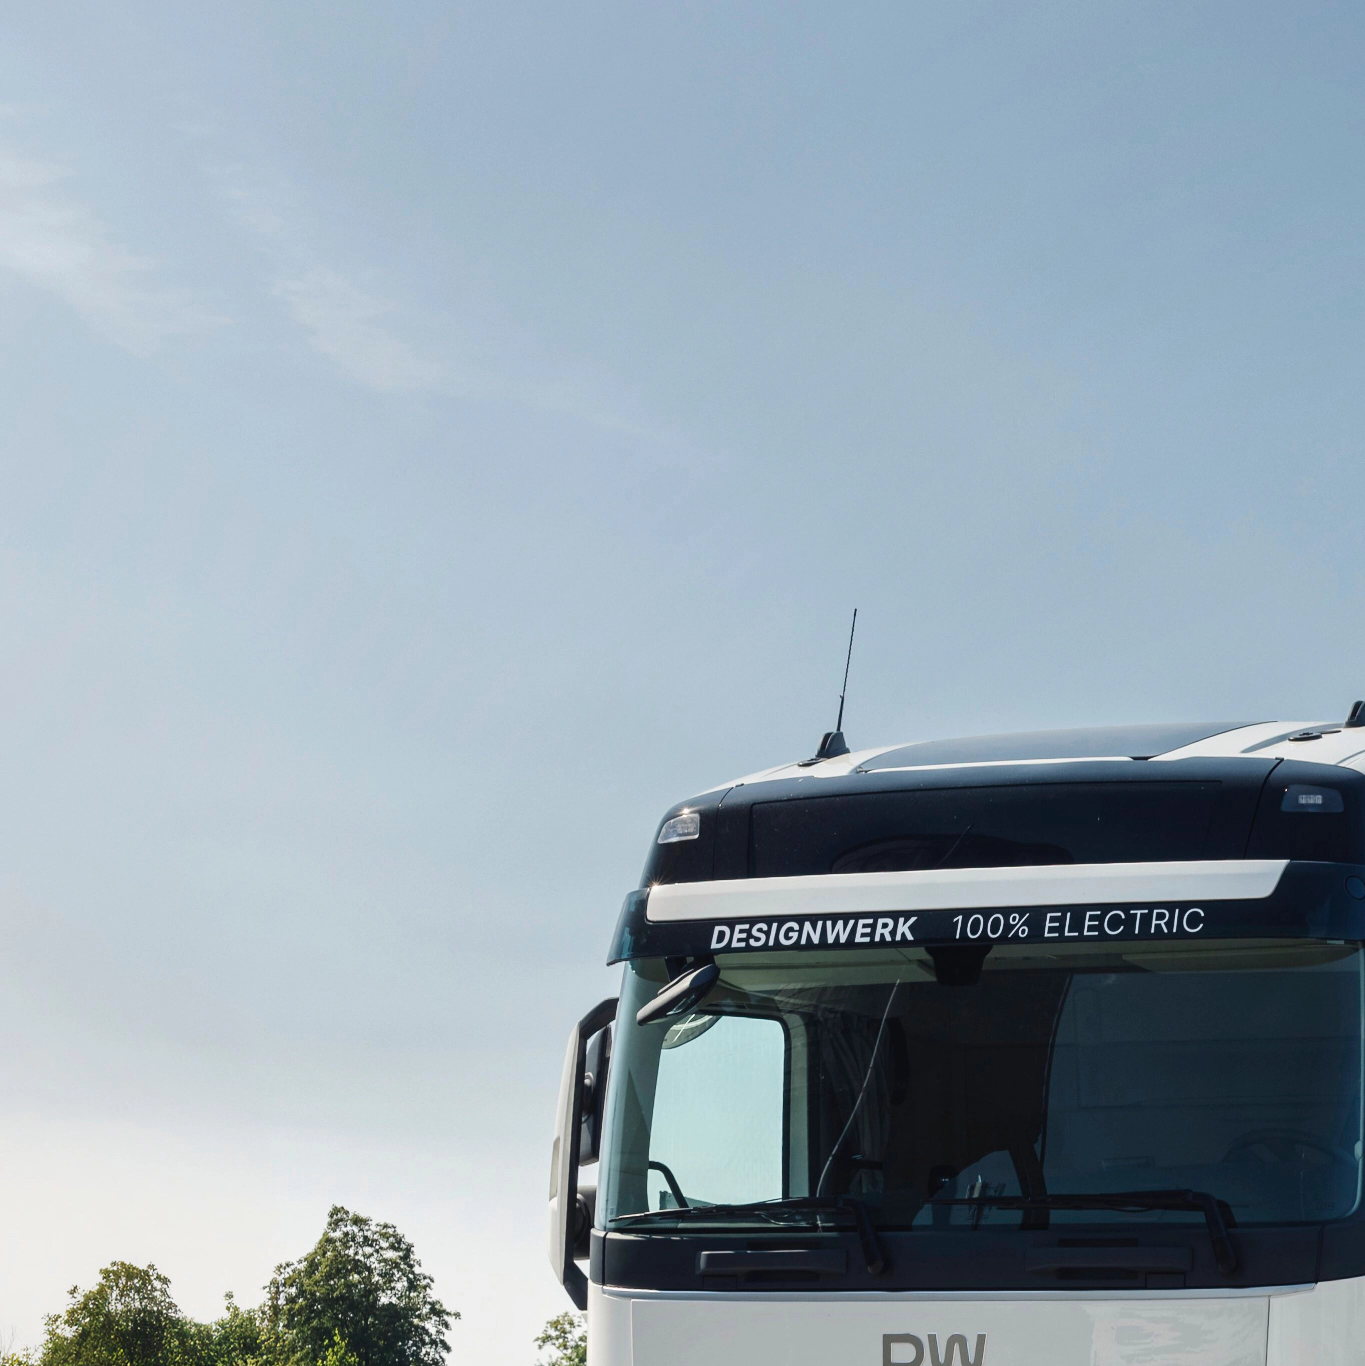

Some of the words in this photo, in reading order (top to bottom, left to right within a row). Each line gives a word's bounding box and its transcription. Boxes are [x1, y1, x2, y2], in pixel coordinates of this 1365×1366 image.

[710, 916, 918, 950] DESIGNWERK
[951, 912, 1029, 940] 100%
[1043, 907, 1206, 938] ELECTRIC
